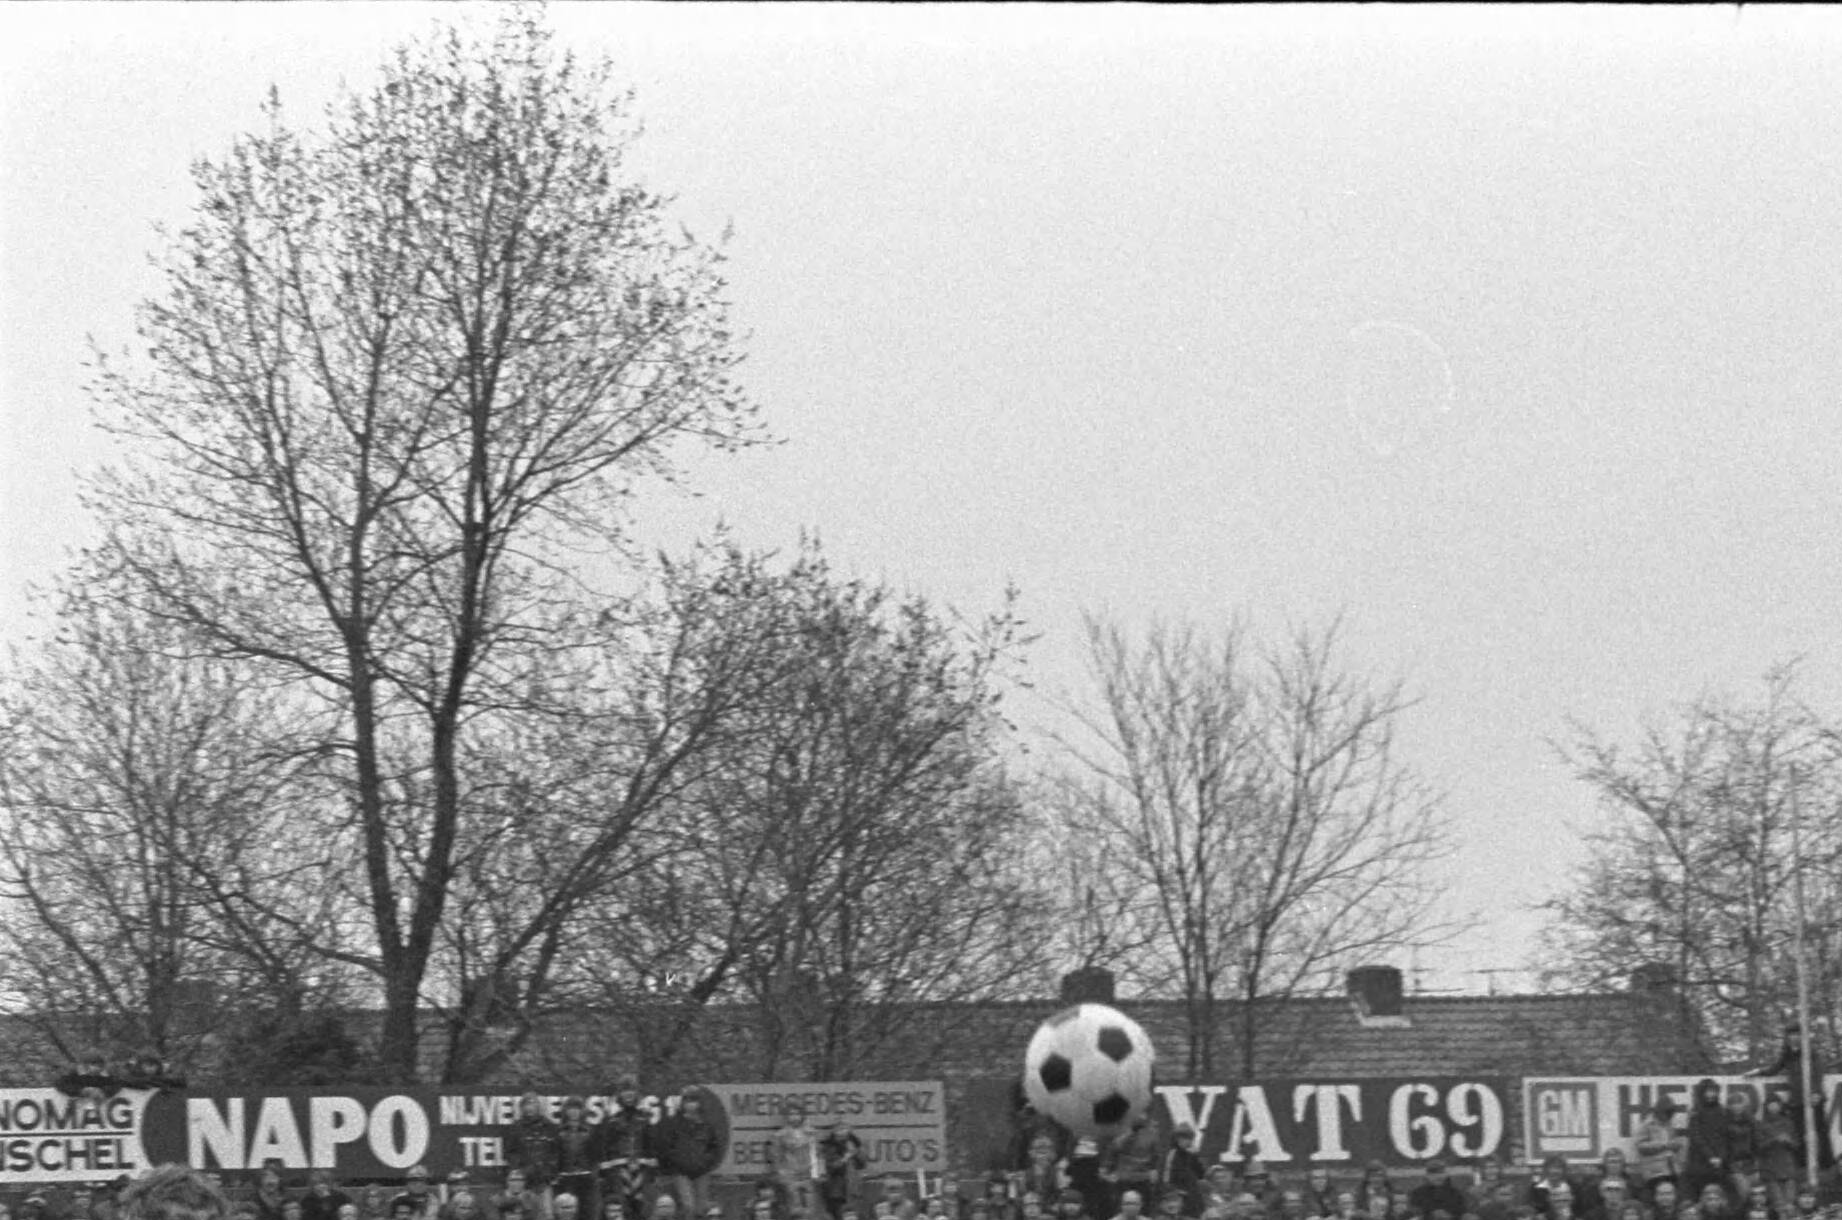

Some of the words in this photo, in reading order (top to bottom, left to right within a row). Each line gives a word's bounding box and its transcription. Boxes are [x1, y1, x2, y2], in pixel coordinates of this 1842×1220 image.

[187, 1095, 430, 1169] NAPO
[1153, 1085, 1362, 1162] VAT
[1388, 1083, 1503, 1159] 69
[1538, 1089, 1591, 1136] GM
[0, 1139, 135, 1172] SCHEL
